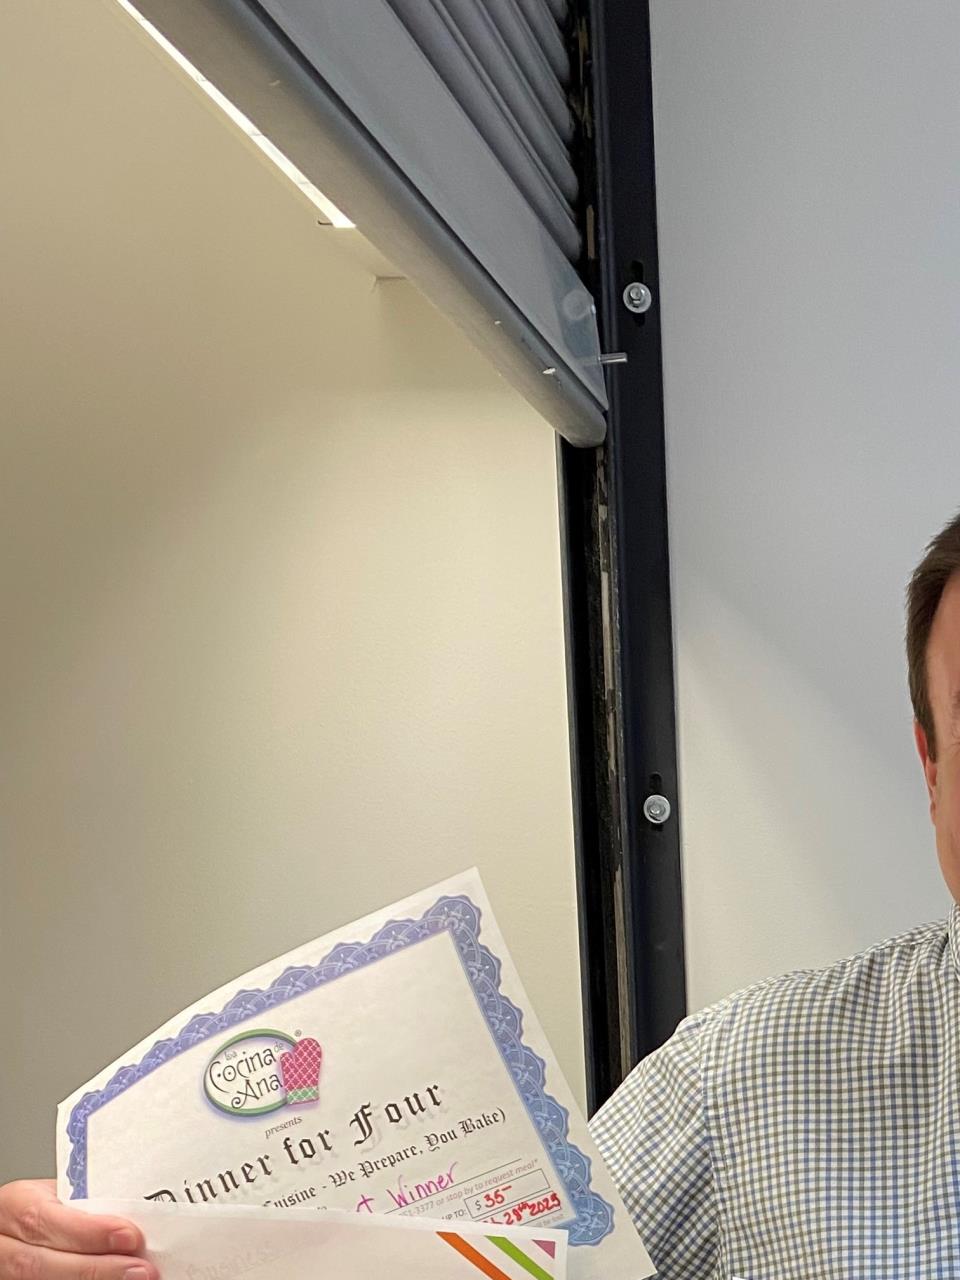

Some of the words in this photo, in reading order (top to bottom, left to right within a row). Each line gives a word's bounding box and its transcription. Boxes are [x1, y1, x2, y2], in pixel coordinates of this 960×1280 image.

[209, 1048, 276, 1093] Cocina
[231, 1074, 283, 1109] Ana
[265, 1116, 302, 1139] presents
[283, 1129, 333, 1165] for
[349, 1084, 441, 1146] Four
[329, 1170, 355, 1187] We
[358, 1144, 423, 1178] Prepare,
[424, 1129, 458, 1152] You
[457, 1107, 506, 1136] Bake)
[386, 1161, 459, 1208] Winner
[485, 1169, 514, 1188] request
